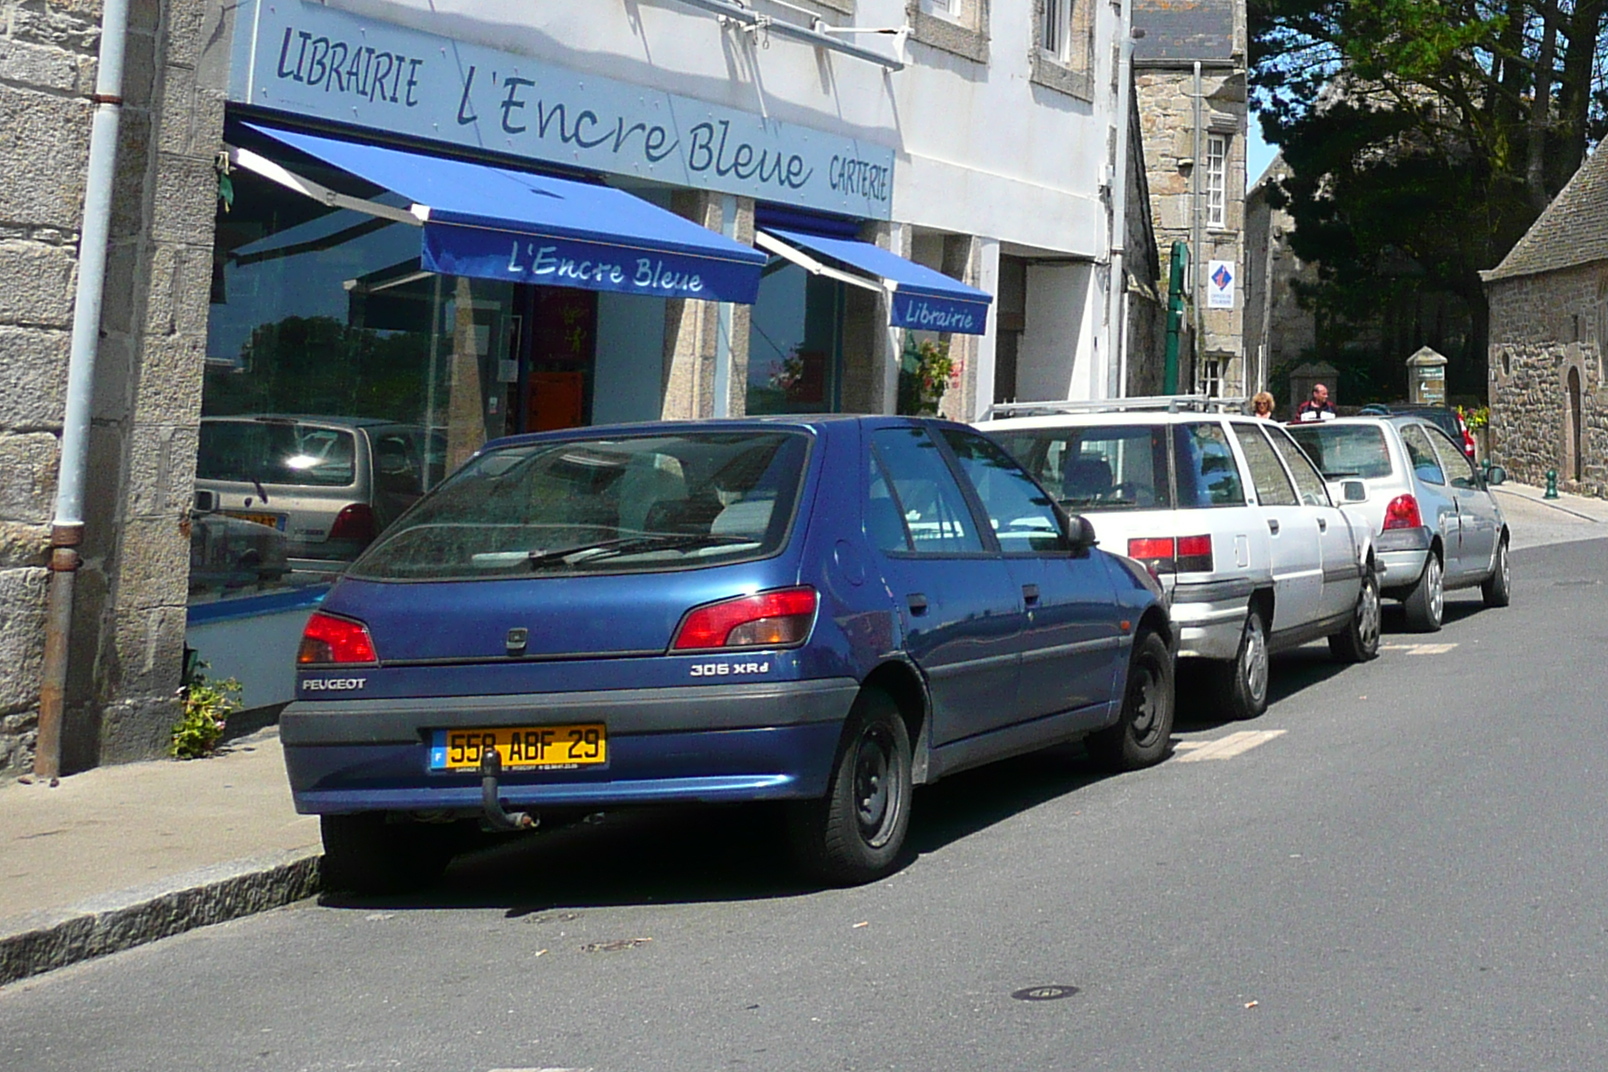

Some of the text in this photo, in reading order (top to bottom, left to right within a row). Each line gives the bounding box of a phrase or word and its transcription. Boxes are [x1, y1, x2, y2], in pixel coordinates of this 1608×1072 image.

[276, 27, 889, 202] LIBRAIRIE L'Encre Bleue CARTERIE
[507, 240, 704, 292] L'Encre Bleue
[905, 299, 974, 328] Librairie
[302, 677, 367, 690] PEUGEOT
[689, 663, 730, 677] 306
[434, 752, 442, 762] F
[509, 730, 555, 761] ABF
[567, 728, 600, 759] 29
